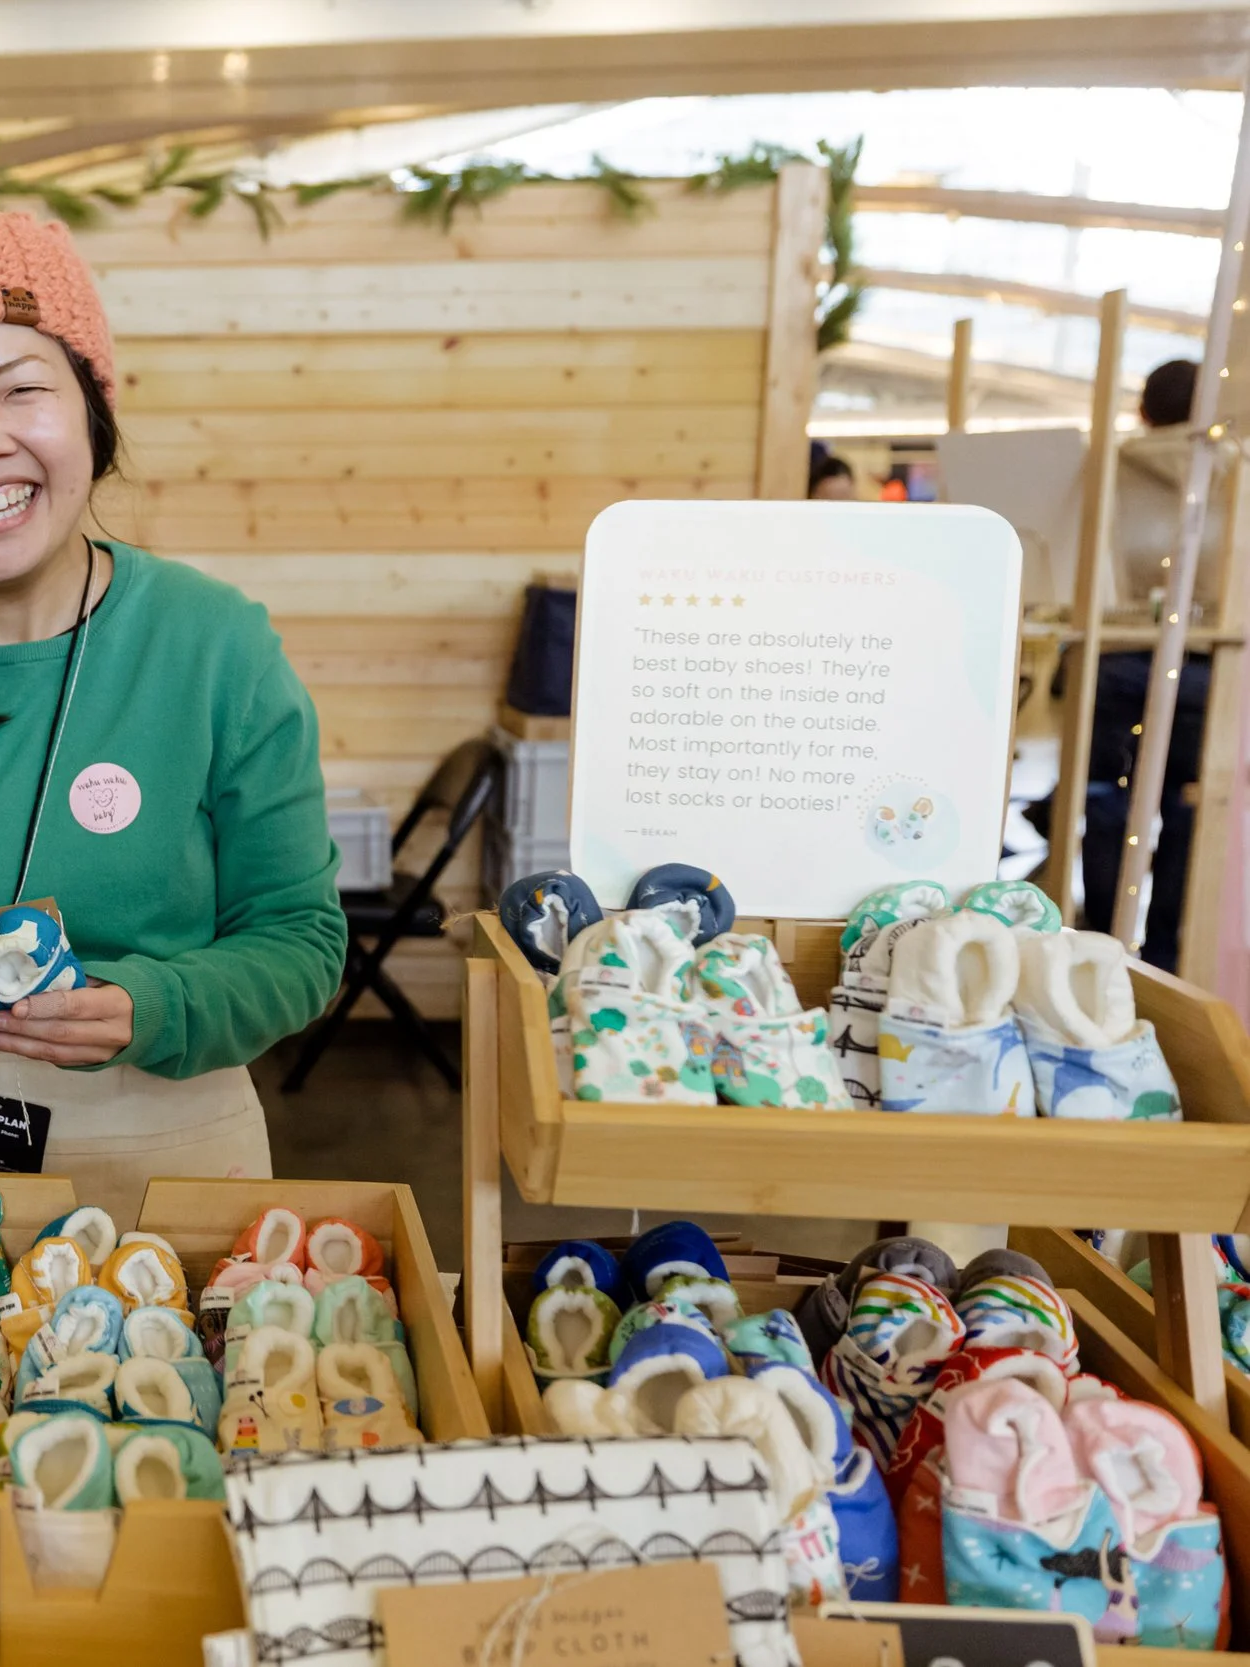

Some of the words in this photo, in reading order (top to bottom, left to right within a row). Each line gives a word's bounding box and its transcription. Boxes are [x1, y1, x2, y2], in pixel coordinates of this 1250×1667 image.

[638, 569, 696, 583] WAKU
[706, 569, 765, 583] WAKU
[775, 570, 896, 586] CUSTOMERS
[633, 627, 701, 646] "These
[707, 633, 742, 646] are
[748, 631, 855, 653] absolutely
[861, 634, 893, 650] the
[632, 655, 678, 672] best
[684, 656, 738, 677] baby
[744, 658, 812, 675] shoes!
[821, 659, 892, 681] They're
[631, 684, 655, 698] so
[662, 681, 700, 699] soft
[706, 686, 733, 700] on
[740, 685, 773, 701] the
[780, 685, 840, 704] inside
[845, 688, 885, 704] and
[629, 709, 724, 727] adorable
[730, 713, 757, 728] on
[763, 712, 796, 729] the
[802, 715, 882, 732] outside.
[628, 736, 677, 752] Most
[683, 736, 802, 760] importantly
[808, 741, 836, 757] for
[842, 744, 878, 761] me,
[627, 762, 671, 781] they
[677, 764, 721, 784] stay
[727, 765, 761, 782] on!
[768, 767, 796, 783] No
[802, 771, 856, 785] more
[624, 787, 661, 805] lost
[667, 790, 725, 807] socks
[732, 794, 753, 808] or
[760, 793, 850, 812] booties!"
[553, 1630, 650, 1658] CLOTH
